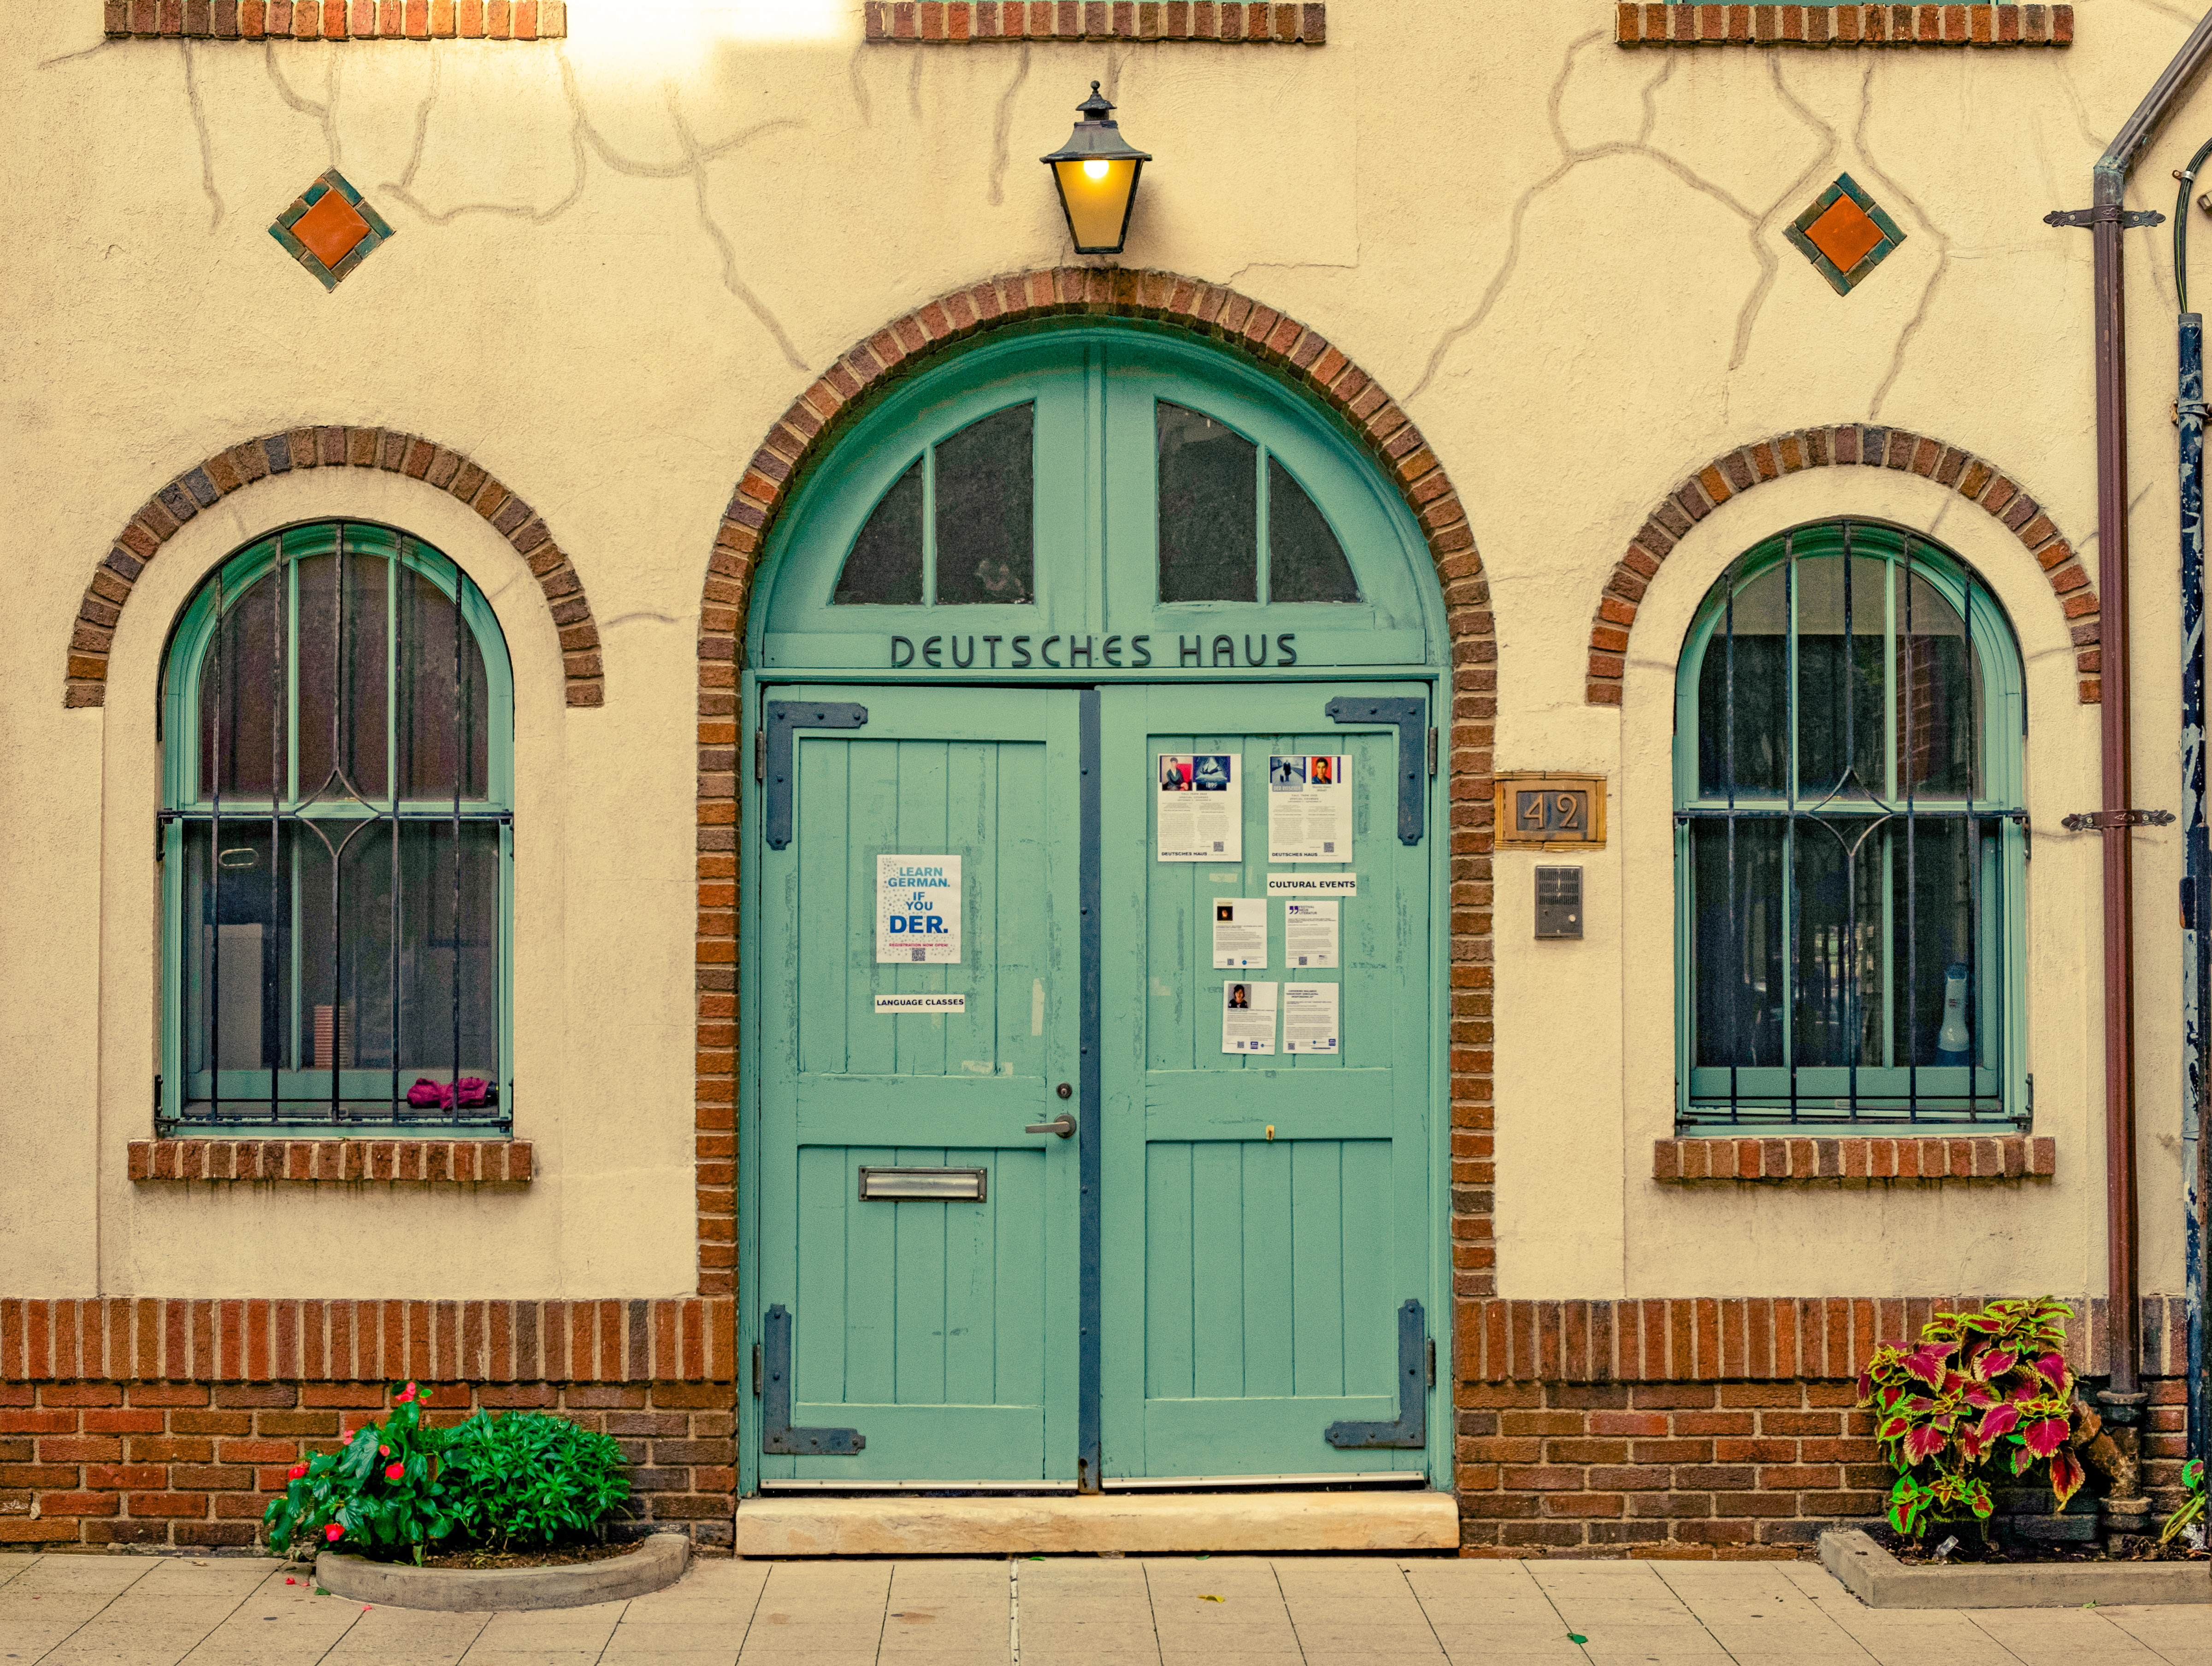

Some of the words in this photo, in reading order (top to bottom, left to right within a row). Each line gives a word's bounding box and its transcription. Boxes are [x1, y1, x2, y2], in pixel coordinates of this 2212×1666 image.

[891, 635, 1151, 668] DEUTSCHES
[1180, 633, 1297, 667] HAUS
[1523, 793, 1578, 828] 42
[899, 867, 943, 876] LEARN
[888, 878, 950, 887] GERMAN.
[913, 892, 925, 901] IF
[906, 901, 932, 910] YOU
[890, 916, 948, 933] DER.
